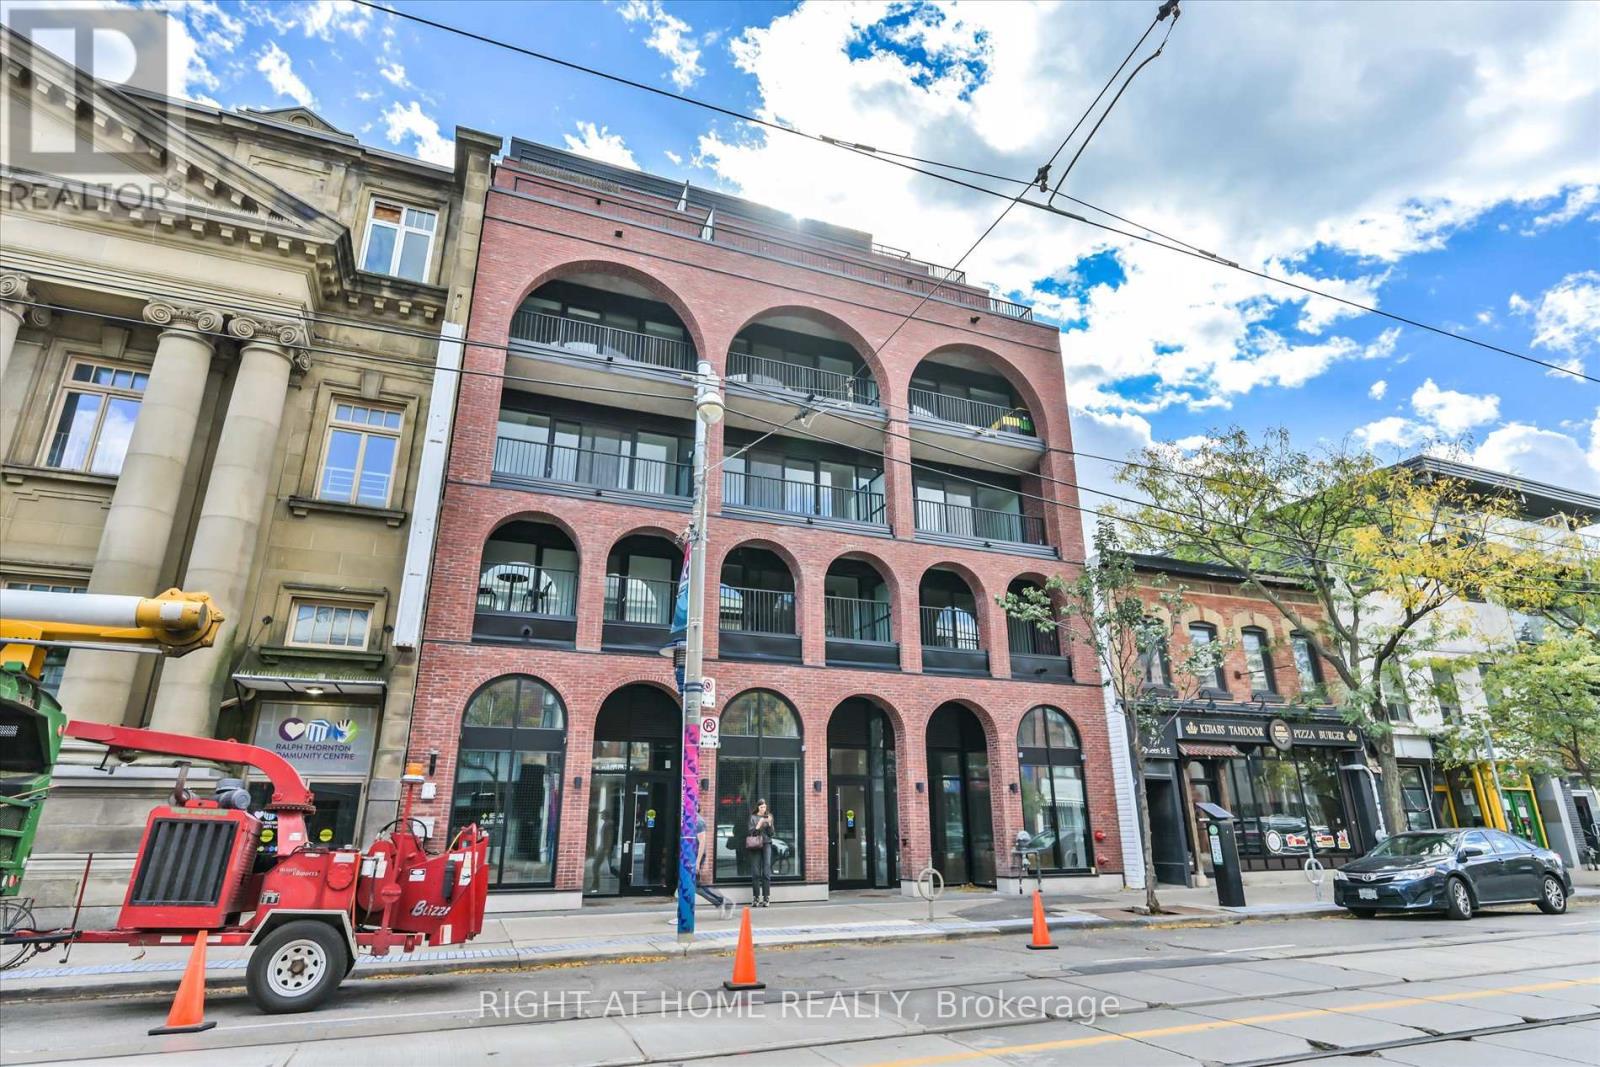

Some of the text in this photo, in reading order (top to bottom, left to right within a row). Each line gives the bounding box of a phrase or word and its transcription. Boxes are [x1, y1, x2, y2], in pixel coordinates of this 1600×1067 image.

[1199, 724, 1226, 735] KEBABS
[1228, 725, 1265, 737] TANDOOR
[1293, 729, 1316, 740] PIZZA
[1318, 730, 1346, 741] BURGER
[275, 743, 351, 752] RALPH THORNTON
[276, 751, 356, 760] OMMUNITY CENTRE
